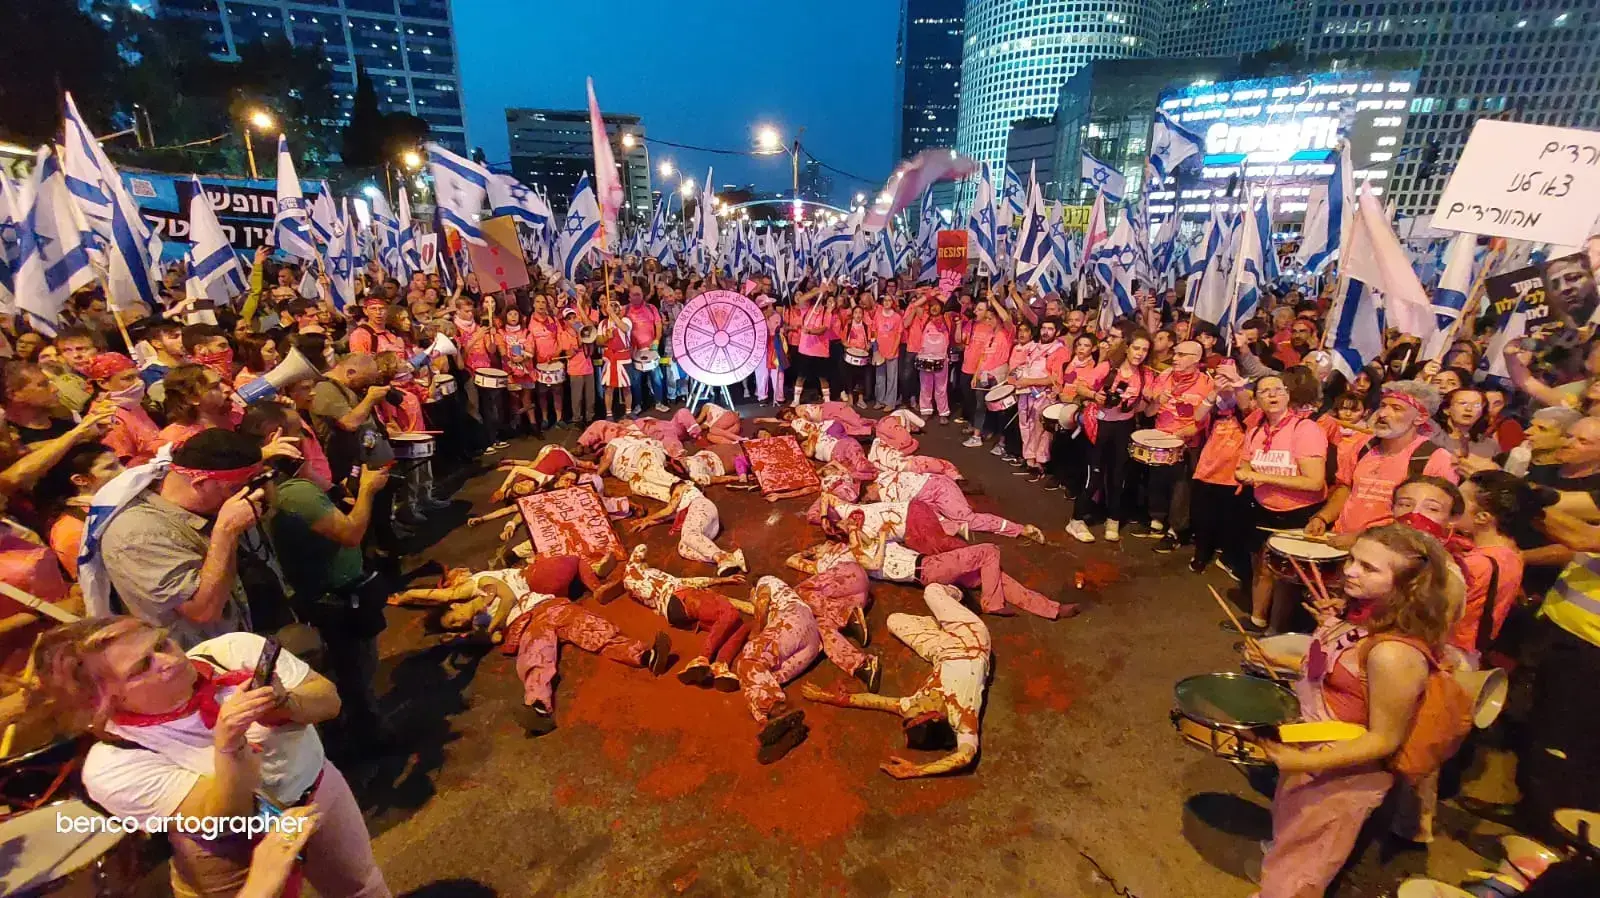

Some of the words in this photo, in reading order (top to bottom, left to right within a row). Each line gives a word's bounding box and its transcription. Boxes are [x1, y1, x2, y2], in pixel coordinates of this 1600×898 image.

[1506, 171, 1543, 192] לנו
[1539, 174, 1575, 197] צאו
[1446, 202, 1542, 228] מהוורידים
[938, 246, 967, 258] RESIST
